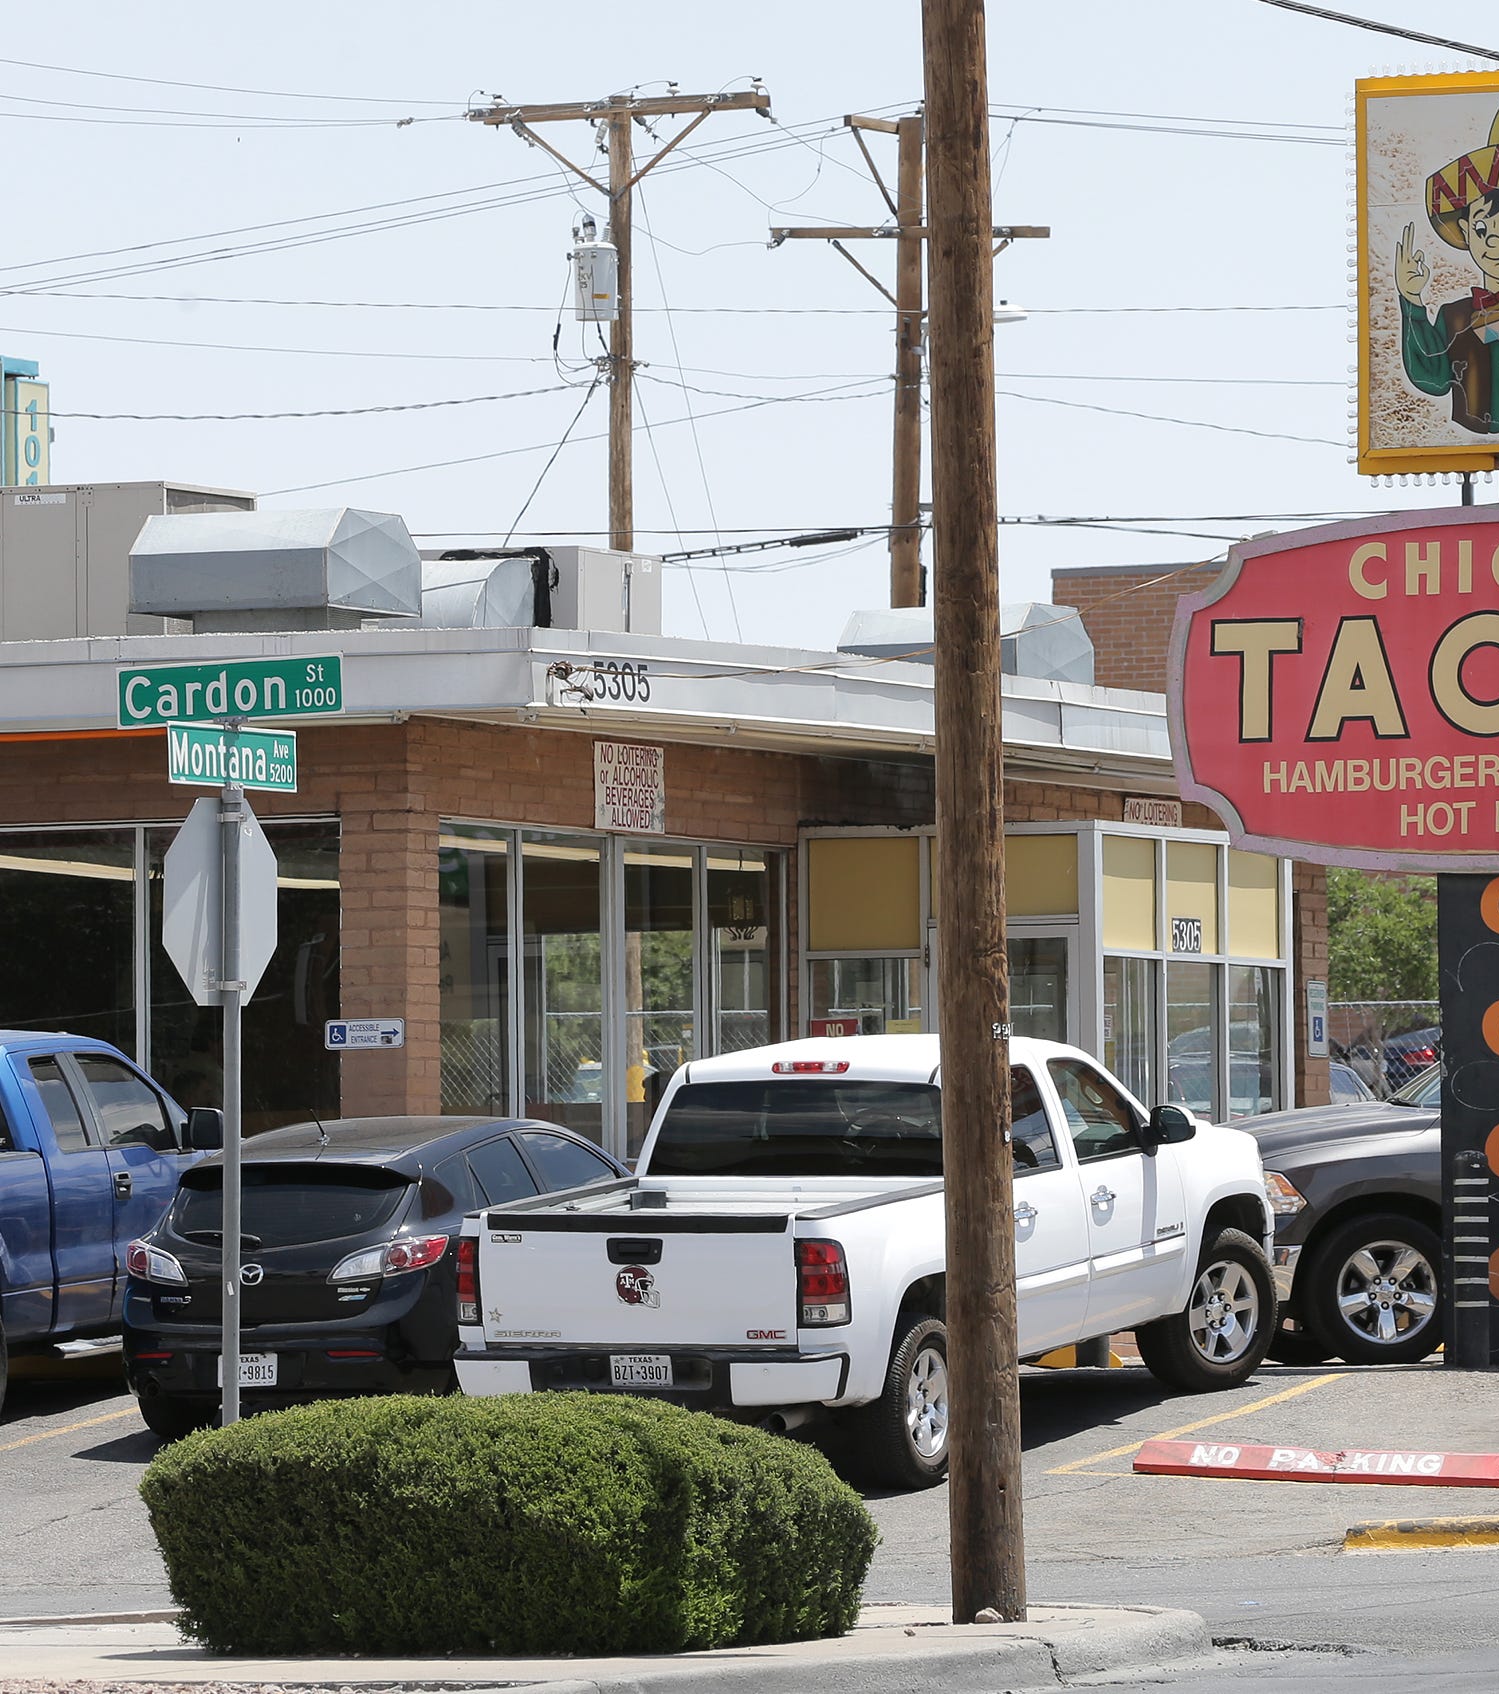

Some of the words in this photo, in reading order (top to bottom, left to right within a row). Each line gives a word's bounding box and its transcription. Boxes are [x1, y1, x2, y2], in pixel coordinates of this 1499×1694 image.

[19, 494, 41, 503] ULTRA
[125, 670, 286, 719] Cardon
[306, 663, 324, 683] St
[593, 661, 651, 702] 5305
[295, 687, 336, 708] 1000
[171, 730, 268, 782] Montana
[273, 740, 289, 760] Ave
[600, 744, 613, 764] NO
[617, 745, 659, 767] LOITERING
[270, 763, 293, 784] 5200
[612, 766, 659, 789] ALCOHOLIC
[605, 786, 654, 809] BEVERAGES
[611, 807, 651, 829] ALLOWED
[1129, 802, 1141, 820] NO
[1144, 802, 1178, 822] LOITERING
[1400, 801, 1477, 836] HOT
[1172, 920, 1201, 951] 5305
[349, 1023, 380, 1032] ACCESSIBLE
[826, 1023, 845, 1037] NO
[350, 1034, 378, 1044] ENTRANCE
[495, 1330, 561, 1338] SIERRA
[746, 1329, 786, 1340] GMC
[1189, 1444, 1242, 1465] NO
[1269, 1448, 1442, 1475] PAKING
